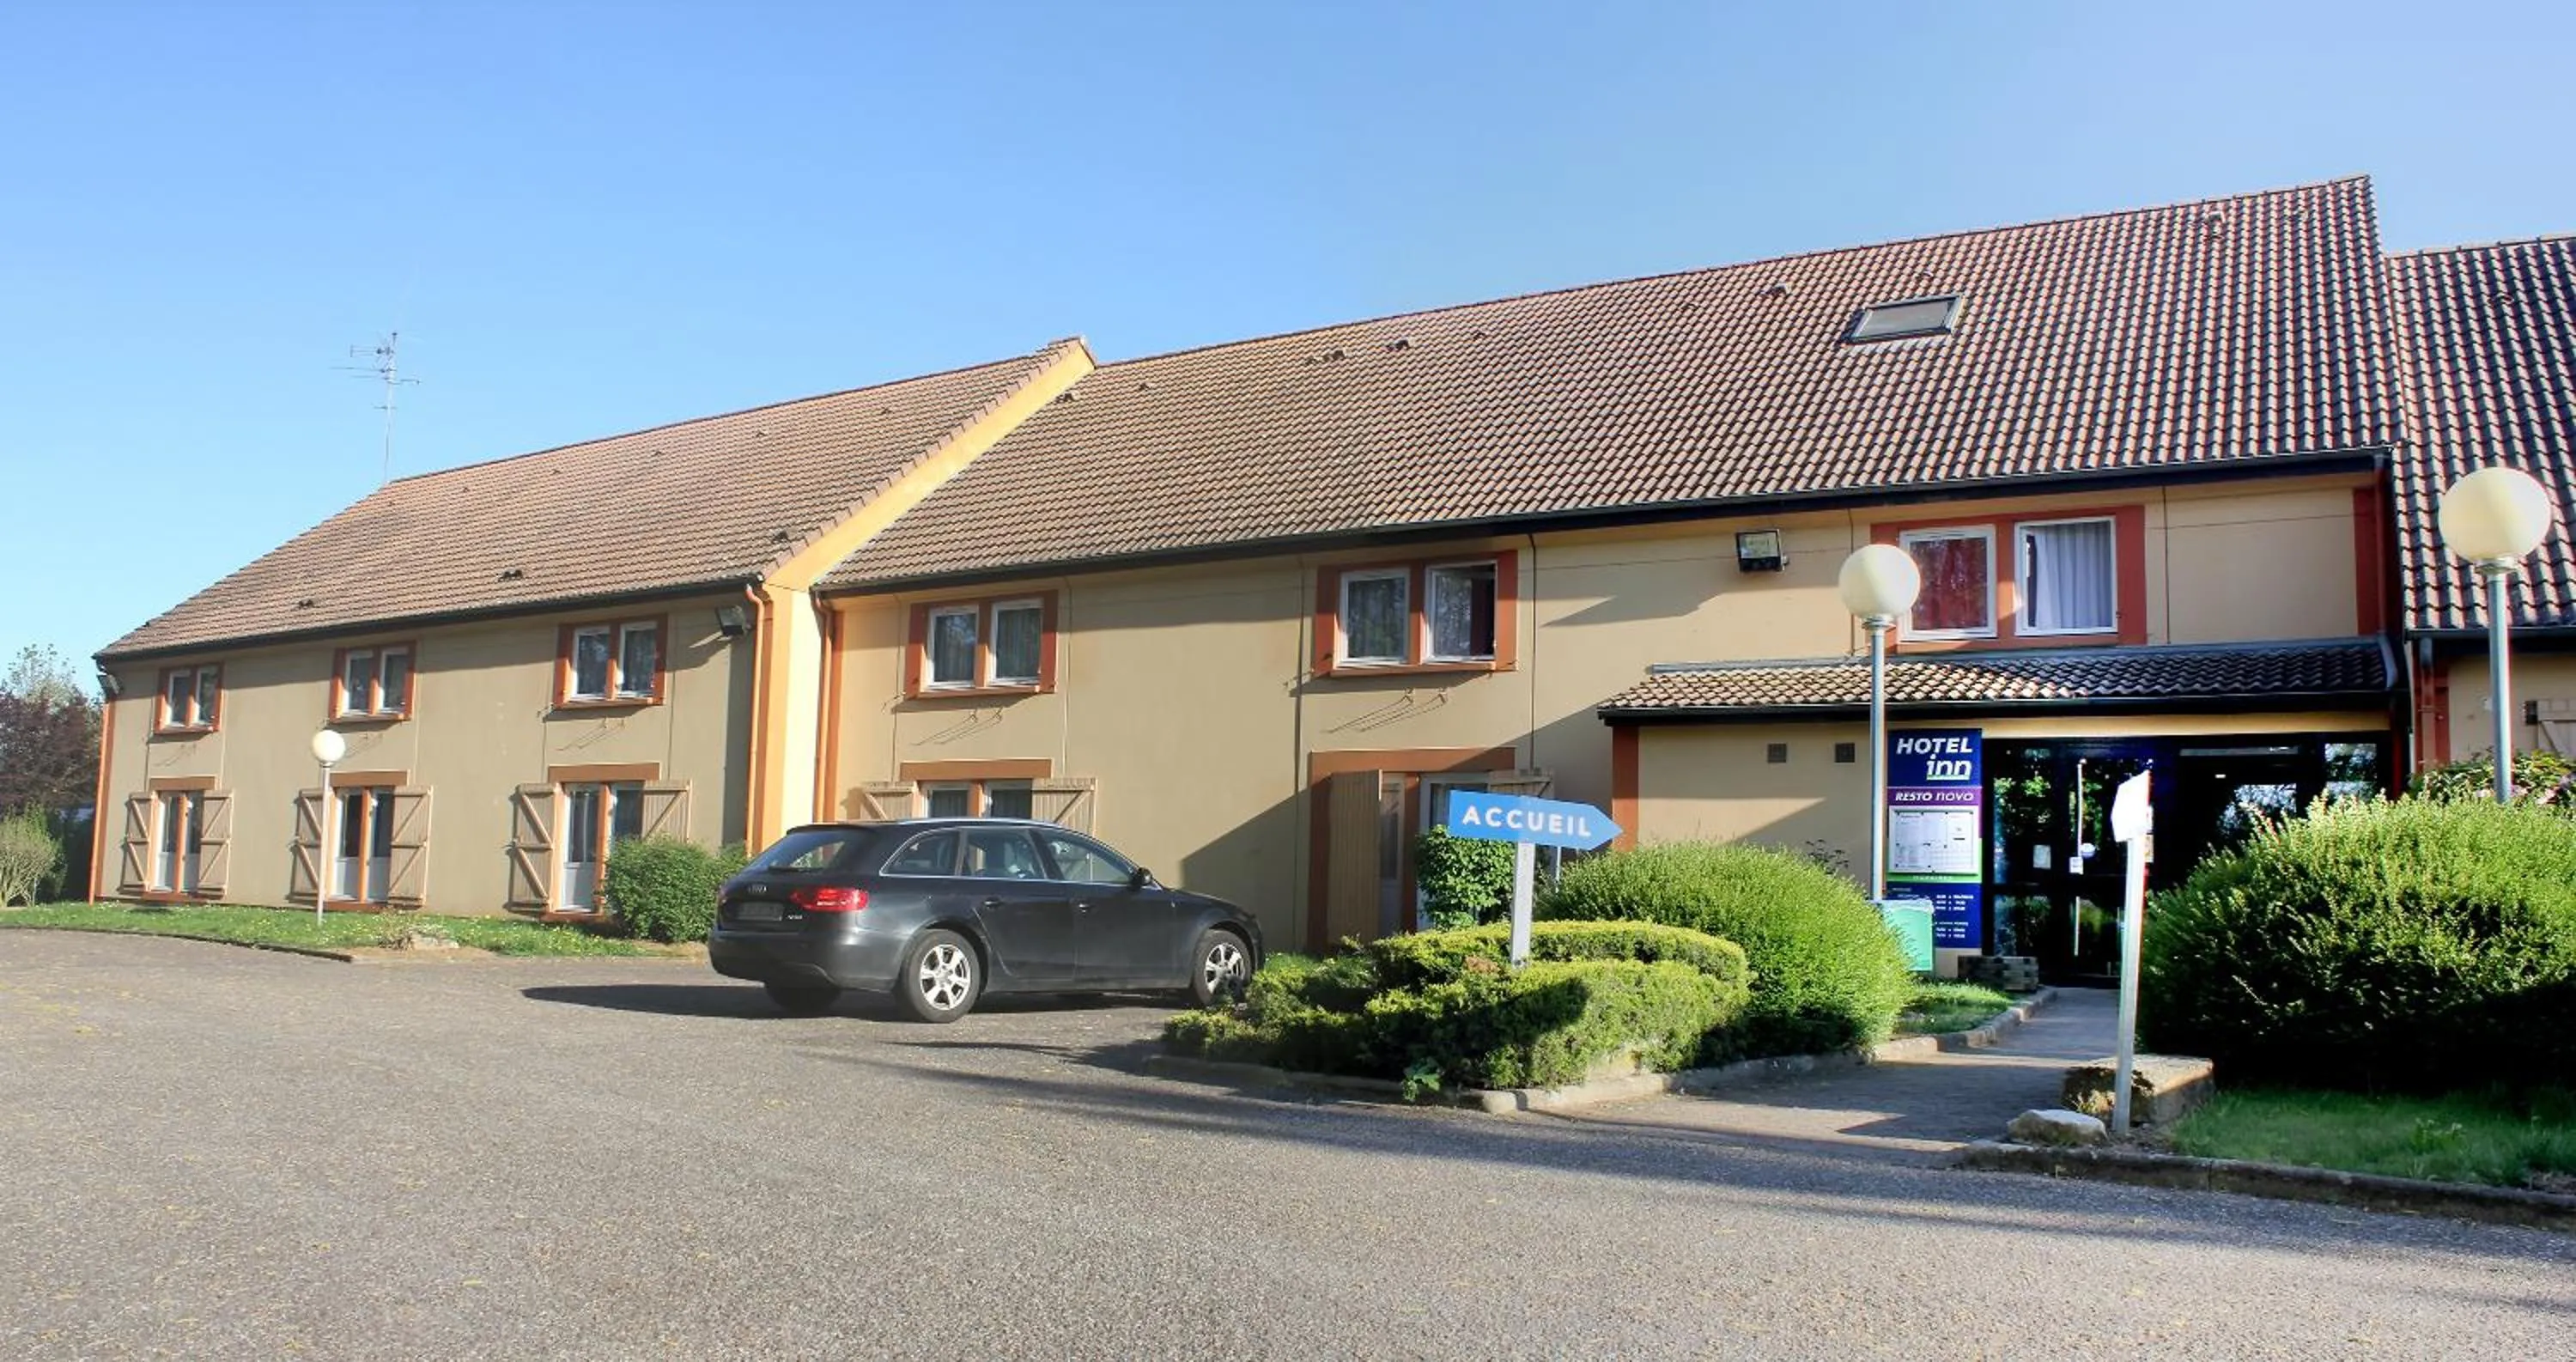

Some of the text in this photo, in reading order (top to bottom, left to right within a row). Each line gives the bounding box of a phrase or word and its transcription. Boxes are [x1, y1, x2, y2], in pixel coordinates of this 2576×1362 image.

[1896, 737, 1973, 755] HOTEL
[1926, 753, 1972, 775] inn
[1895, 792, 1932, 801] RESTO
[1461, 806, 1592, 837] ACCUEIL
